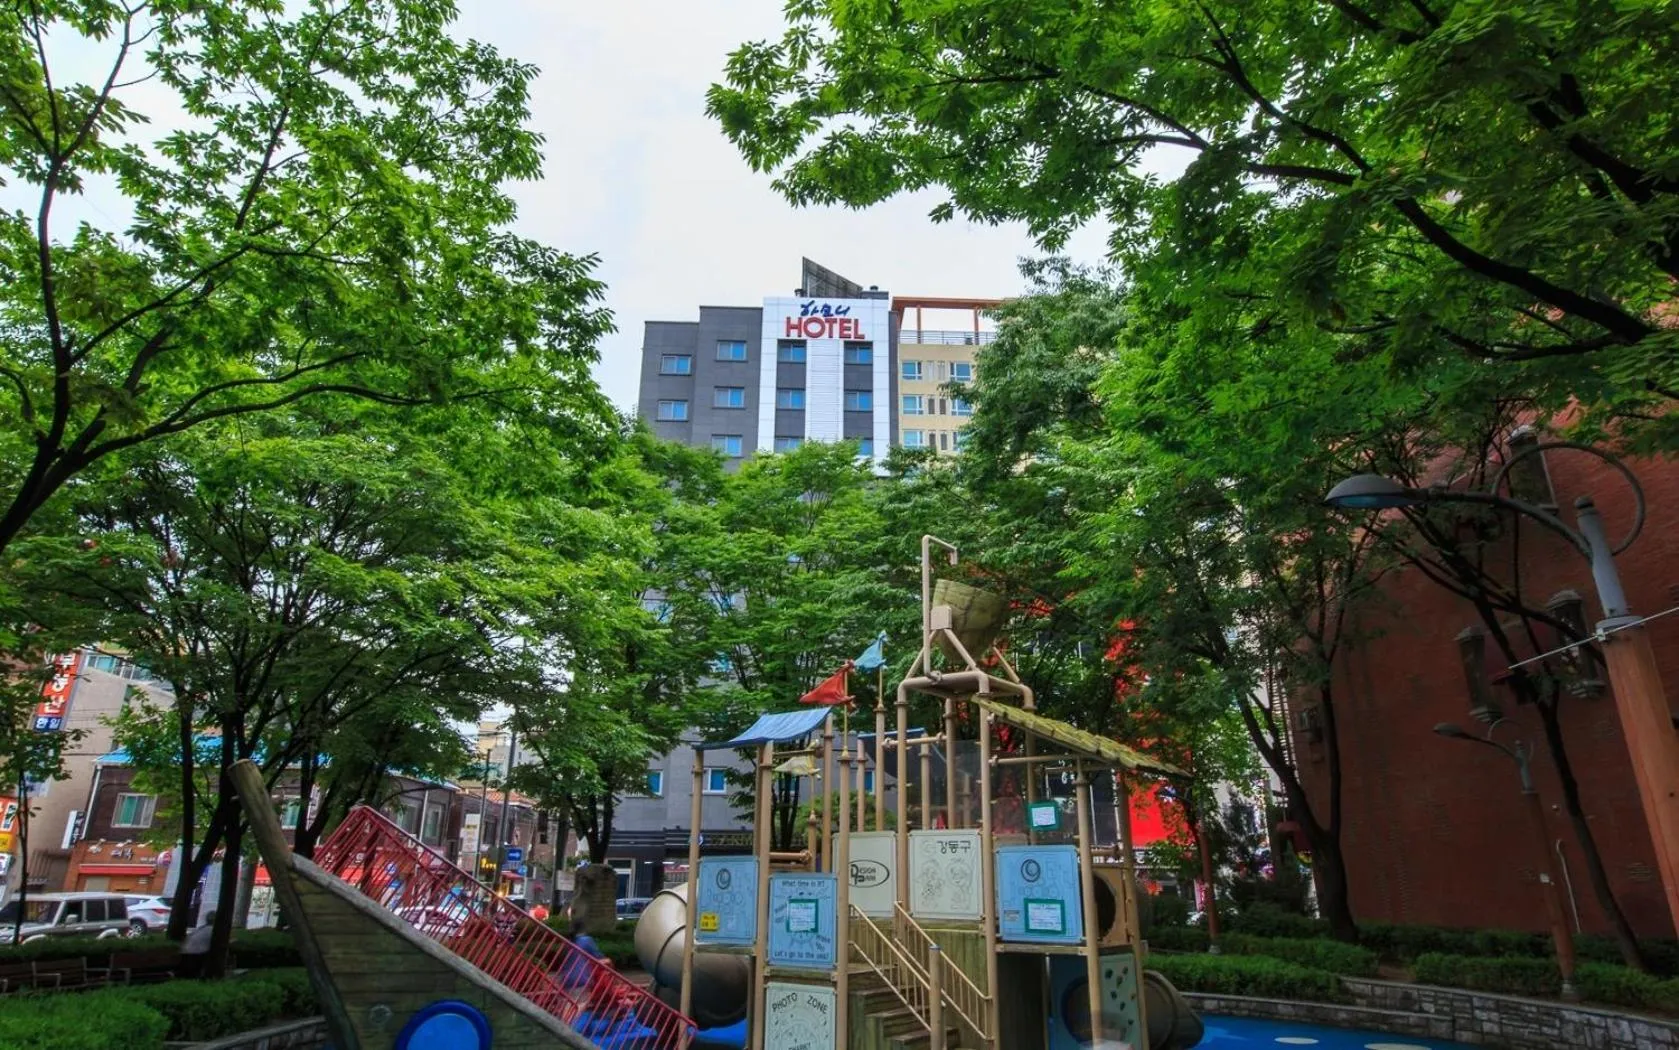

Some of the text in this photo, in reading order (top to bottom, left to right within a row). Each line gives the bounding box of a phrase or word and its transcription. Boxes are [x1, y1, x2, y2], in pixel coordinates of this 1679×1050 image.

[786, 316, 866, 339] HOTEL
[937, 840, 971, 854] 강동구
[771, 992, 829, 1015] PHOTO ZONE
